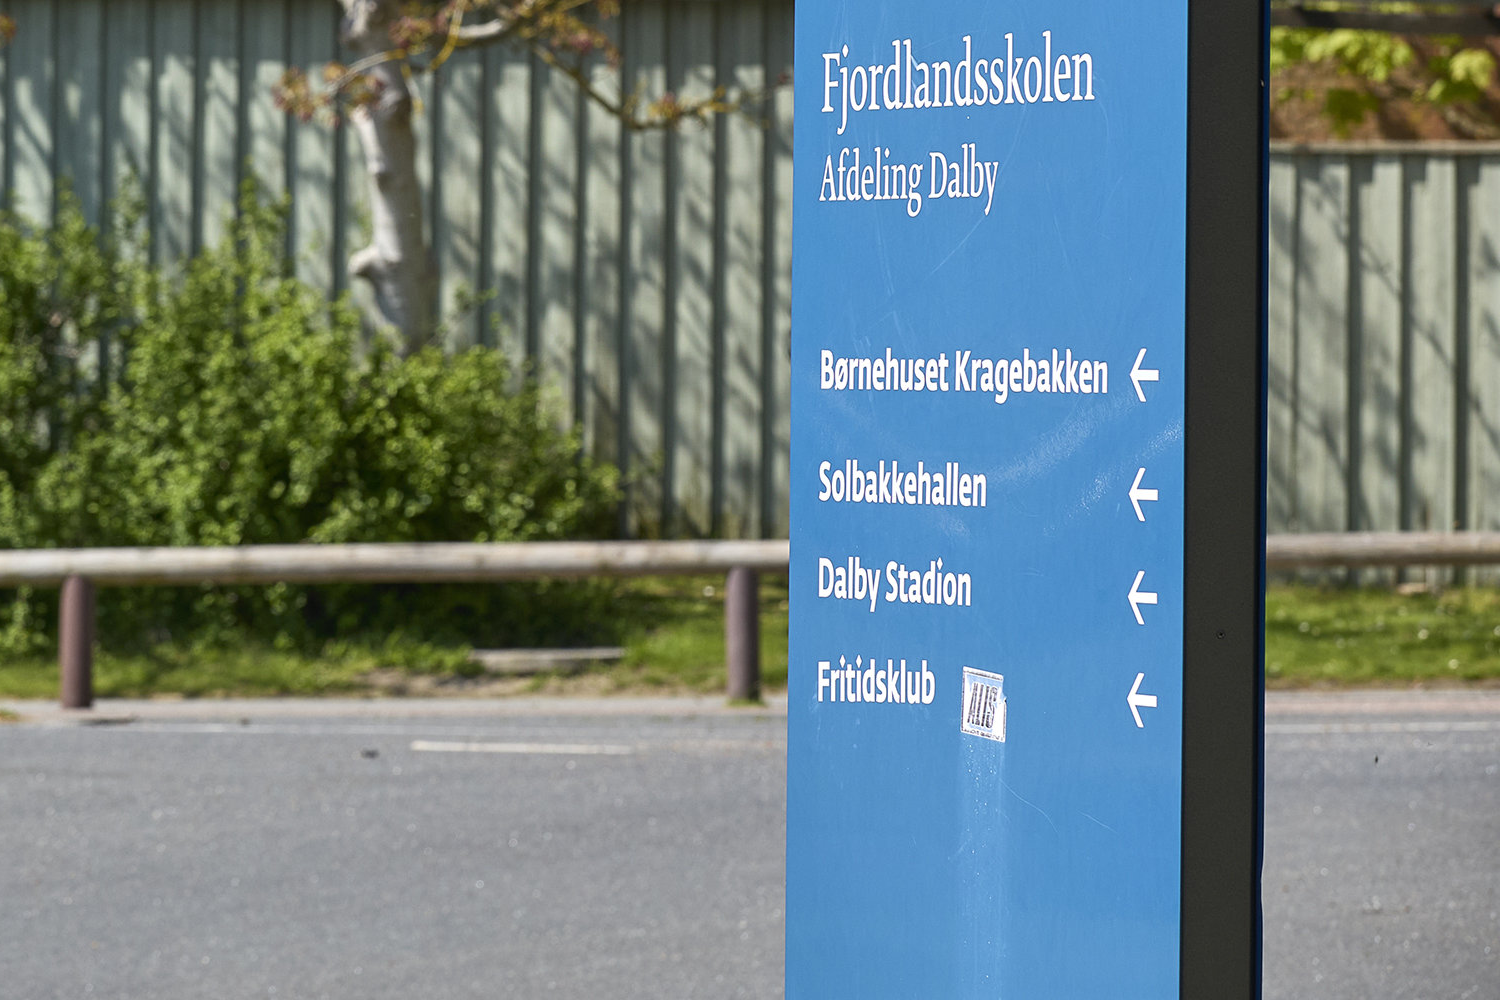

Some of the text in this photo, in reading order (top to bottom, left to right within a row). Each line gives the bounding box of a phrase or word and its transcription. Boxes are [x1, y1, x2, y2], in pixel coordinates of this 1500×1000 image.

[821, 30, 1096, 136] Fjordlandsskolen
[819, 143, 999, 218] Afdeling Dalby
[820, 347, 1108, 405] Børnehuset Kragebakken
[818, 459, 987, 507] Solbakkehallen
[818, 556, 972, 612] Dalby Stadion
[817, 655, 936, 705] Fritidsklub
